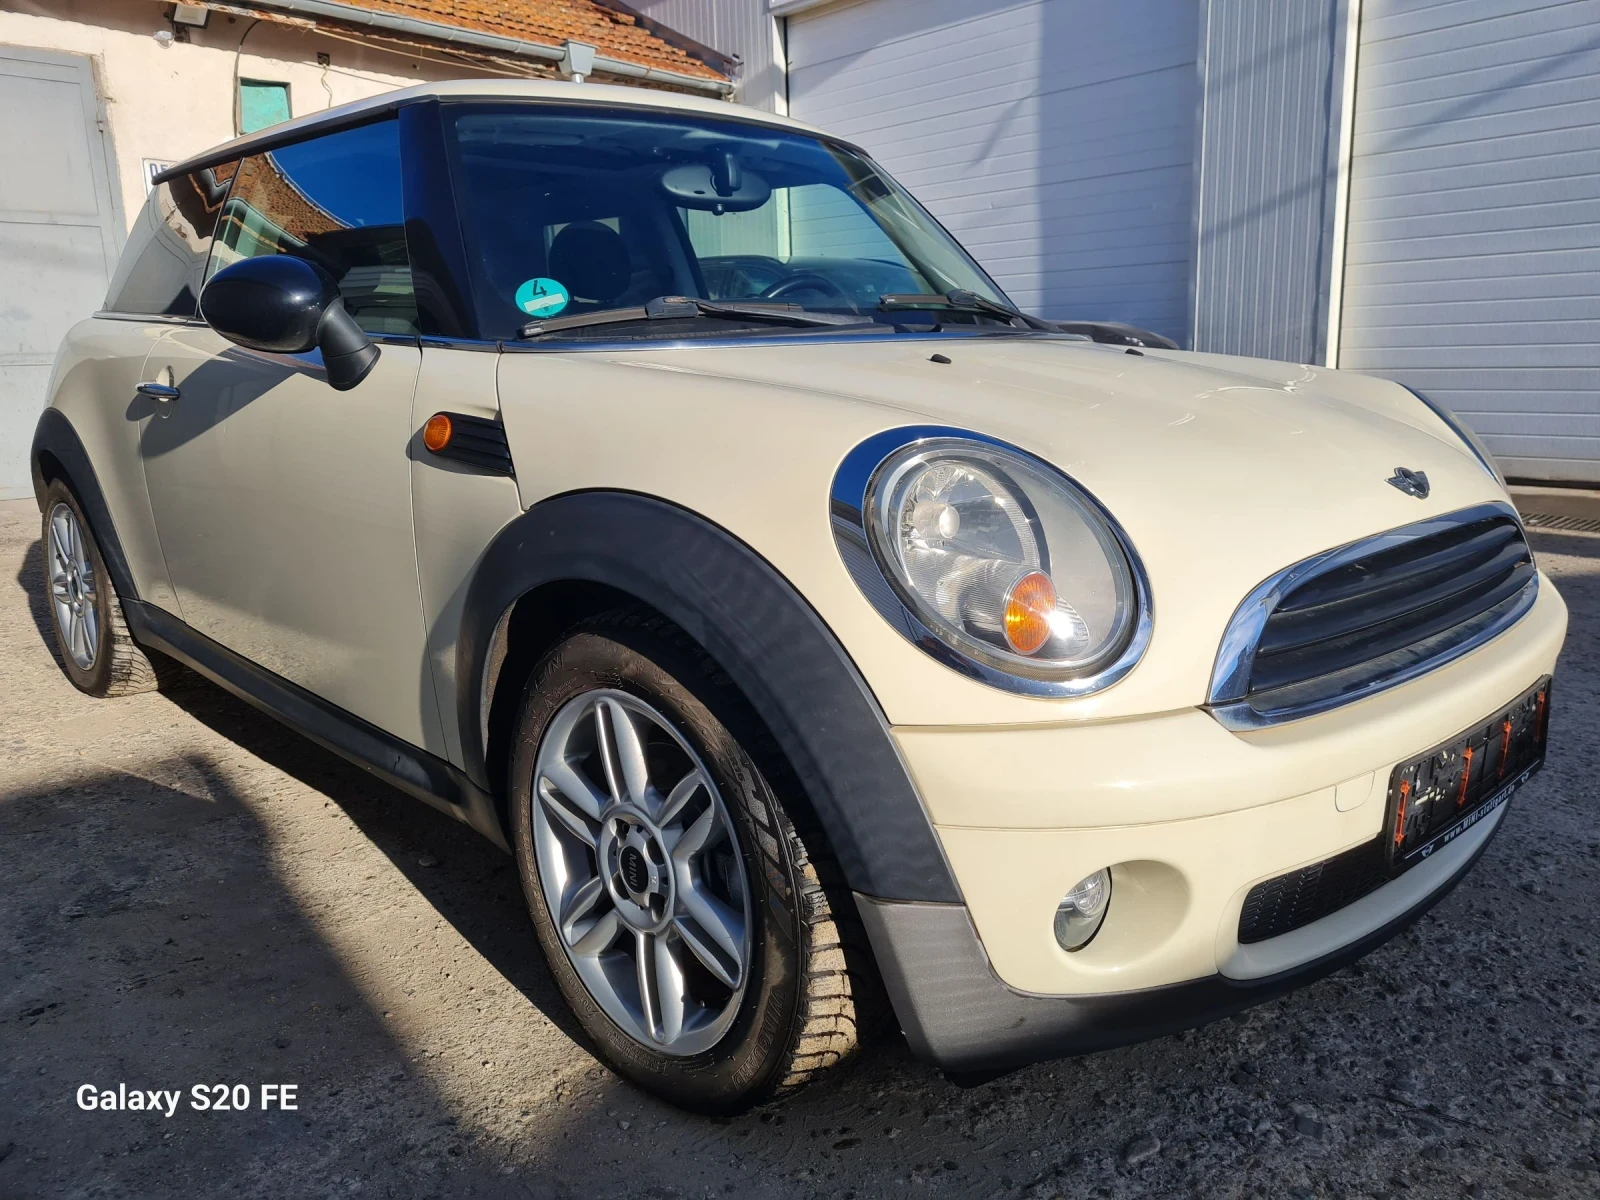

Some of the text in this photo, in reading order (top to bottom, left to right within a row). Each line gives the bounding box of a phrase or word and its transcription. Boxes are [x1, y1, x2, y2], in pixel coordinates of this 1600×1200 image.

[532, 279, 547, 296] 4
[1444, 784, 1515, 843] www.MINI-stuttgart.de
[628, 853, 638, 887] MINI
[732, 987, 785, 1090] WINGUARD
